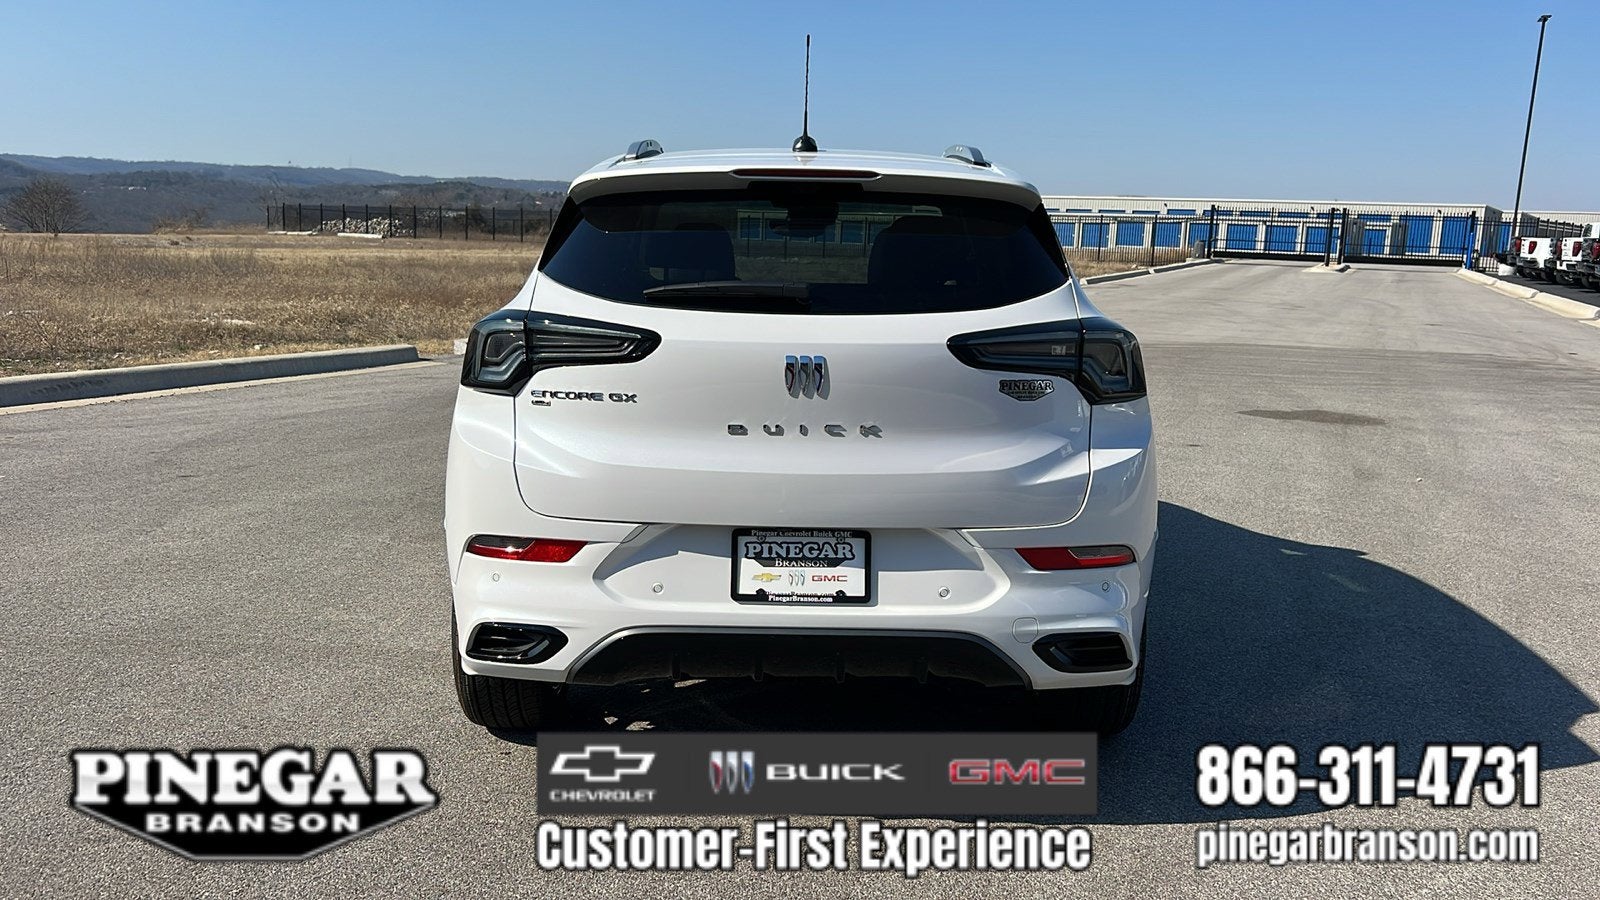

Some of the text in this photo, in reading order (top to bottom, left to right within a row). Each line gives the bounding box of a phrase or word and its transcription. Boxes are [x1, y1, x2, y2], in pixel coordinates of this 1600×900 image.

[1001, 380, 1053, 391] PINEGAR
[531, 390, 638, 404] ENCORE GX
[727, 424, 883, 439] BUICK
[834, 530, 853, 539] GMC
[746, 542, 854, 559] PINEGAR
[811, 574, 849, 583] GMC
[768, 595, 834, 603] PinegarBranson.com
